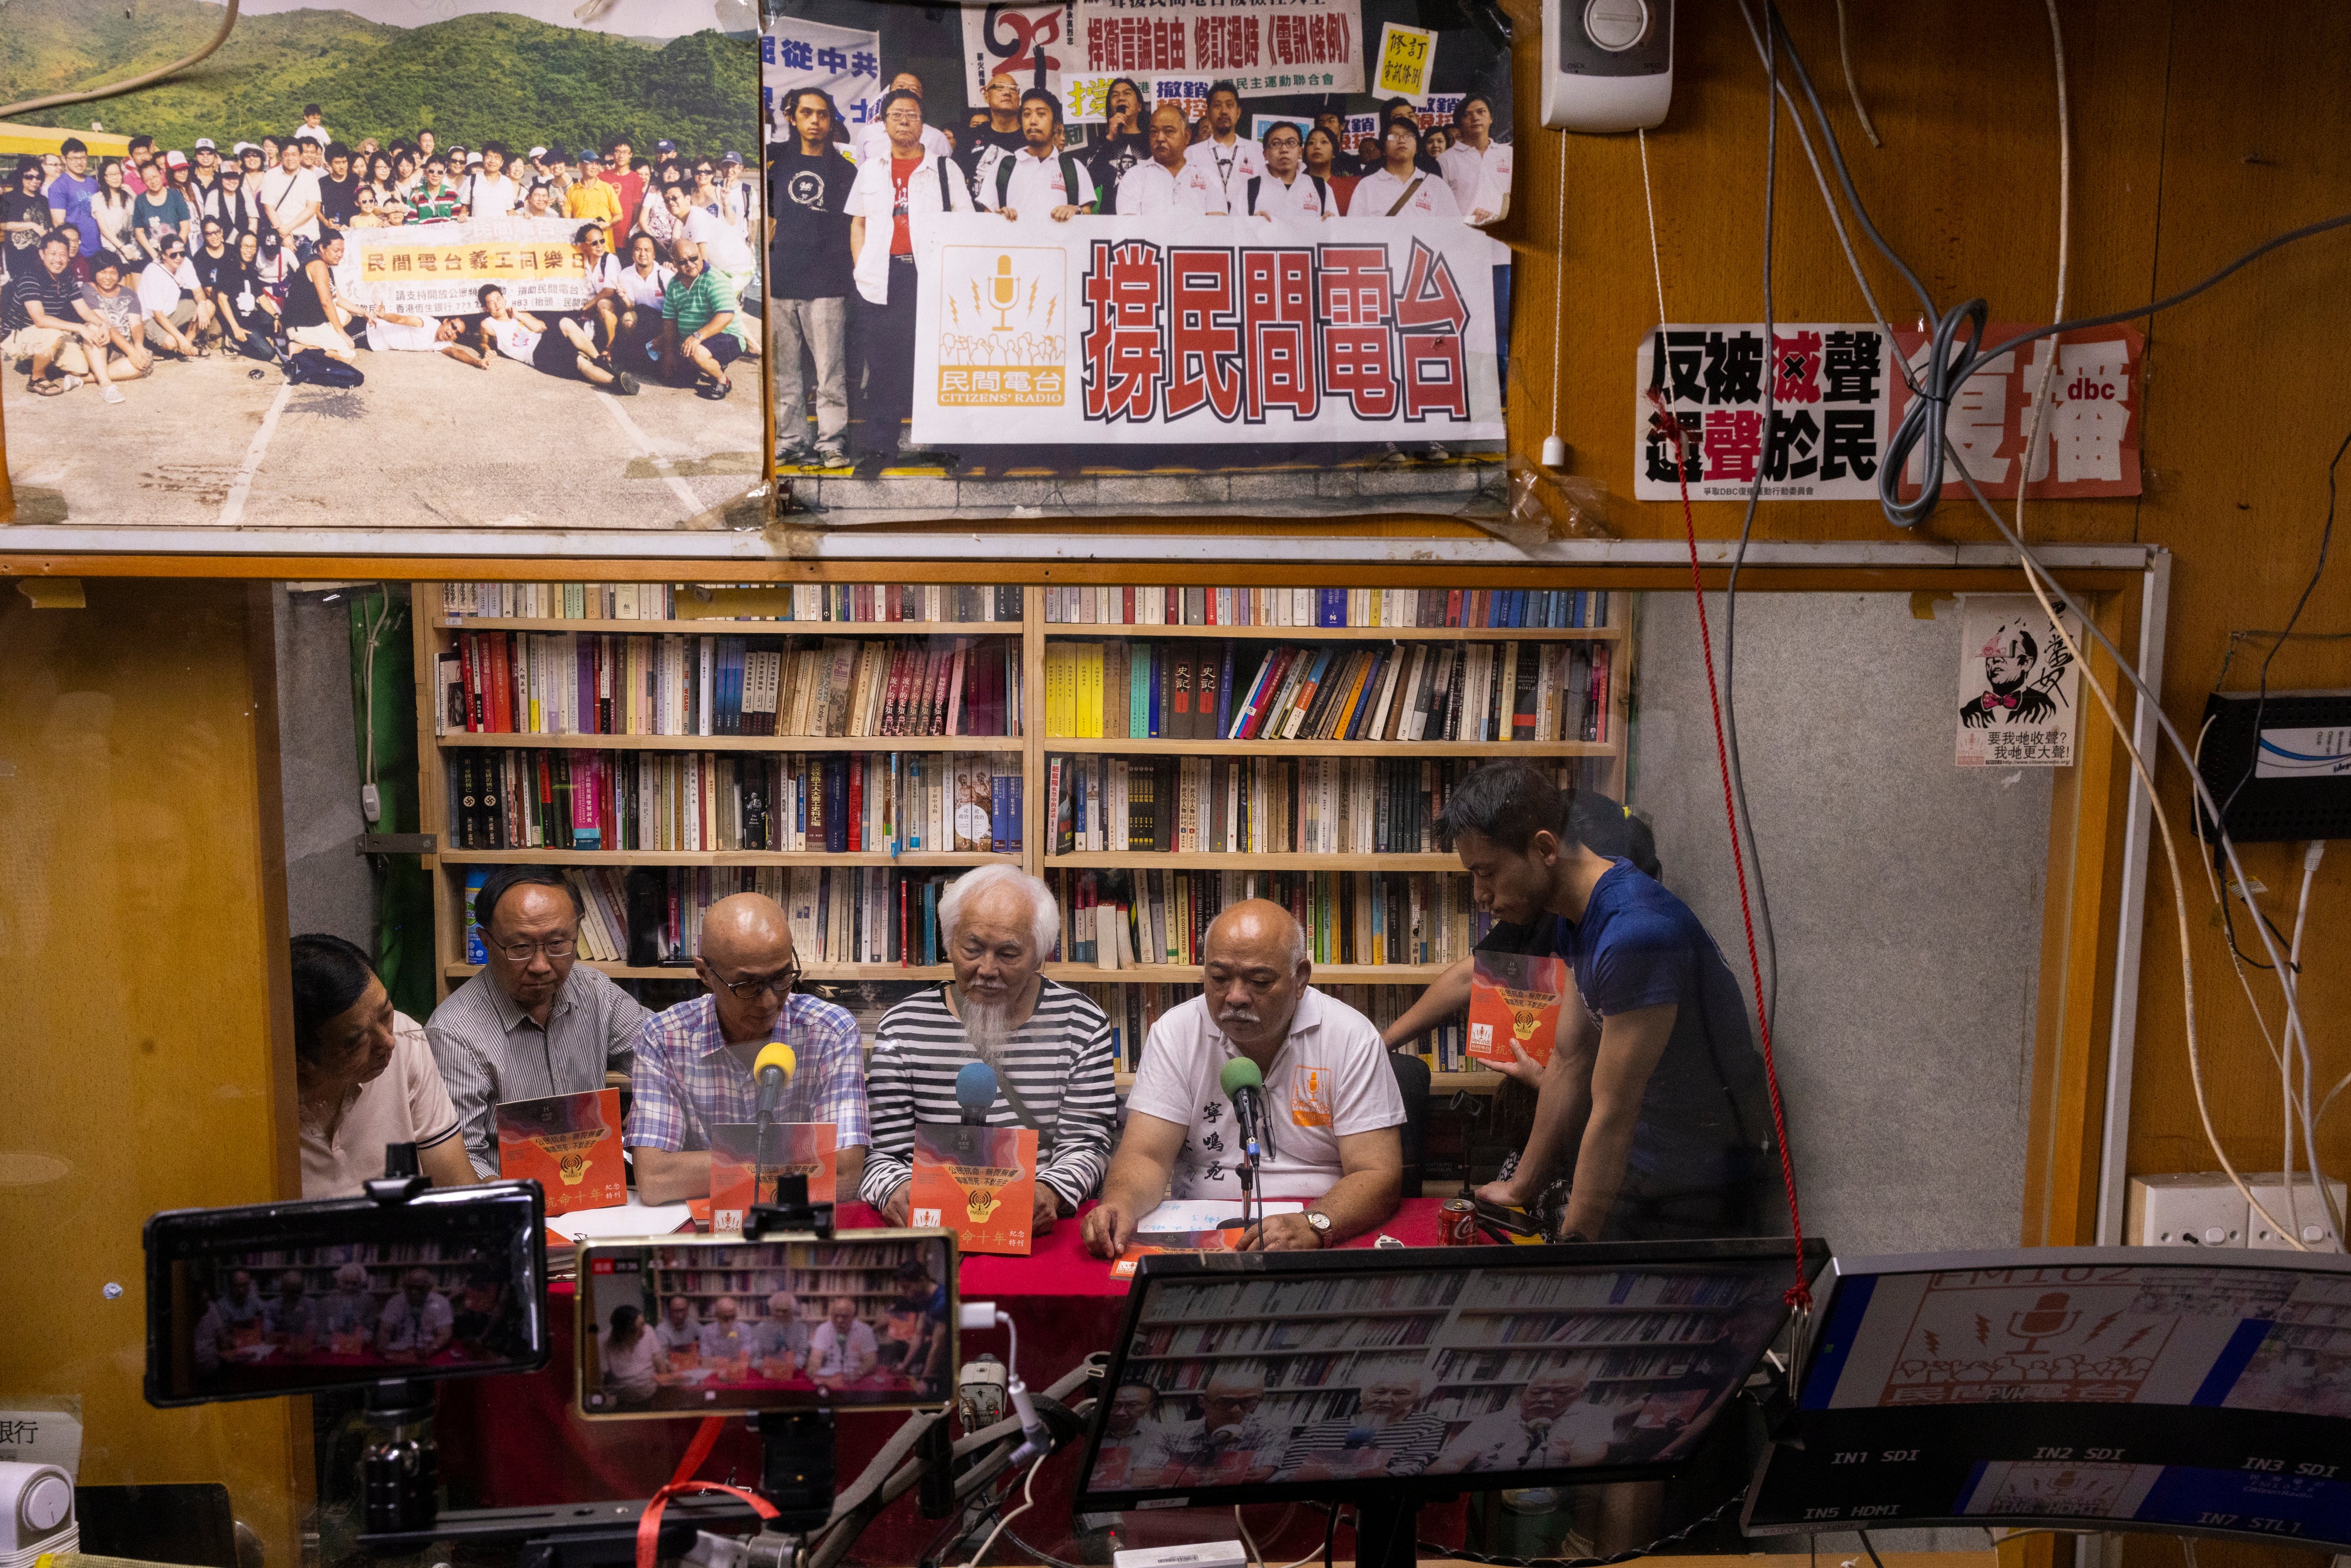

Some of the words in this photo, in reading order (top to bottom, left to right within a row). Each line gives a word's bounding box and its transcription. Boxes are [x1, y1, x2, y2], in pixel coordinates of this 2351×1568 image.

[1194, 15, 1259, 69] 修訂過時
[1390, 33, 1427, 60] 修訂
[941, 371, 1062, 393] 民間電台
[2067, 377, 2115, 401] dbc
[941, 394, 1012, 403] CITIZENS'
[1014, 394, 1061, 403] RADIO
[1175, 666, 1191, 689] 史記
[1200, 666, 1216, 689] 史記
[885, 676, 898, 714] 流亡的先知
[897, 676, 910, 714] 流亡的先知
[606, 1182, 621, 1191] 紀念
[606, 1191, 621, 1200] 特刊
[1831, 1451, 1869, 1465] IN1
[1881, 1449, 1920, 1462] SDI
[2033, 1447, 2074, 1459] IN2
[2085, 1448, 2125, 1461] SDI
[2242, 1457, 2285, 1471] IN3
[2296, 1462, 2340, 1477] SDI
[1803, 1507, 1839, 1520] IN5
[1850, 1504, 1901, 1517] HDMI
[2198, 1512, 2237, 1526] IN7
